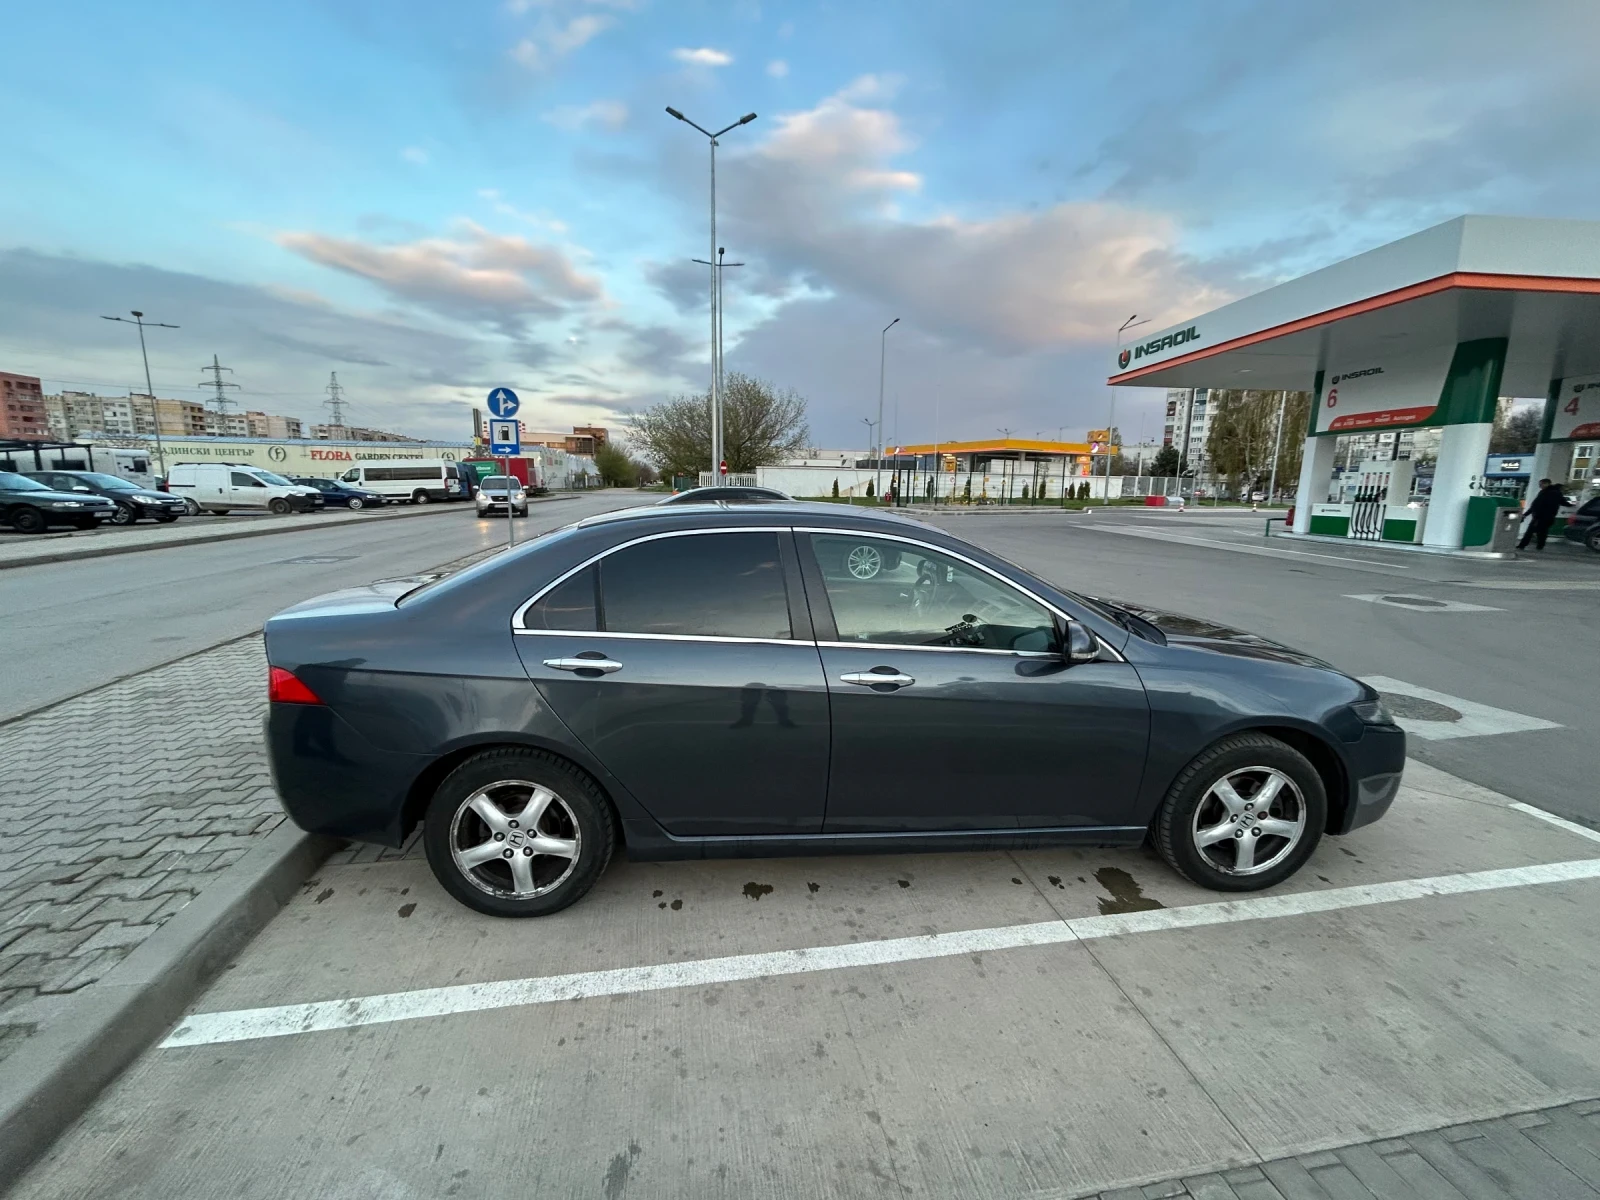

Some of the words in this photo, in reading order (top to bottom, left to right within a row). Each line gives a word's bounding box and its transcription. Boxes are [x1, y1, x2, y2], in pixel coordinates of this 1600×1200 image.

[1134, 326, 1200, 359] INSAOIL
[1341, 367, 1385, 380] INSAOIL
[1327, 388, 1338, 408] 6
[1564, 396, 1580, 416] 4
[215, 448, 254, 457] ЦЕНТЪР
[310, 450, 352, 460] FLORA
[355, 452, 391, 460] GARDEN
